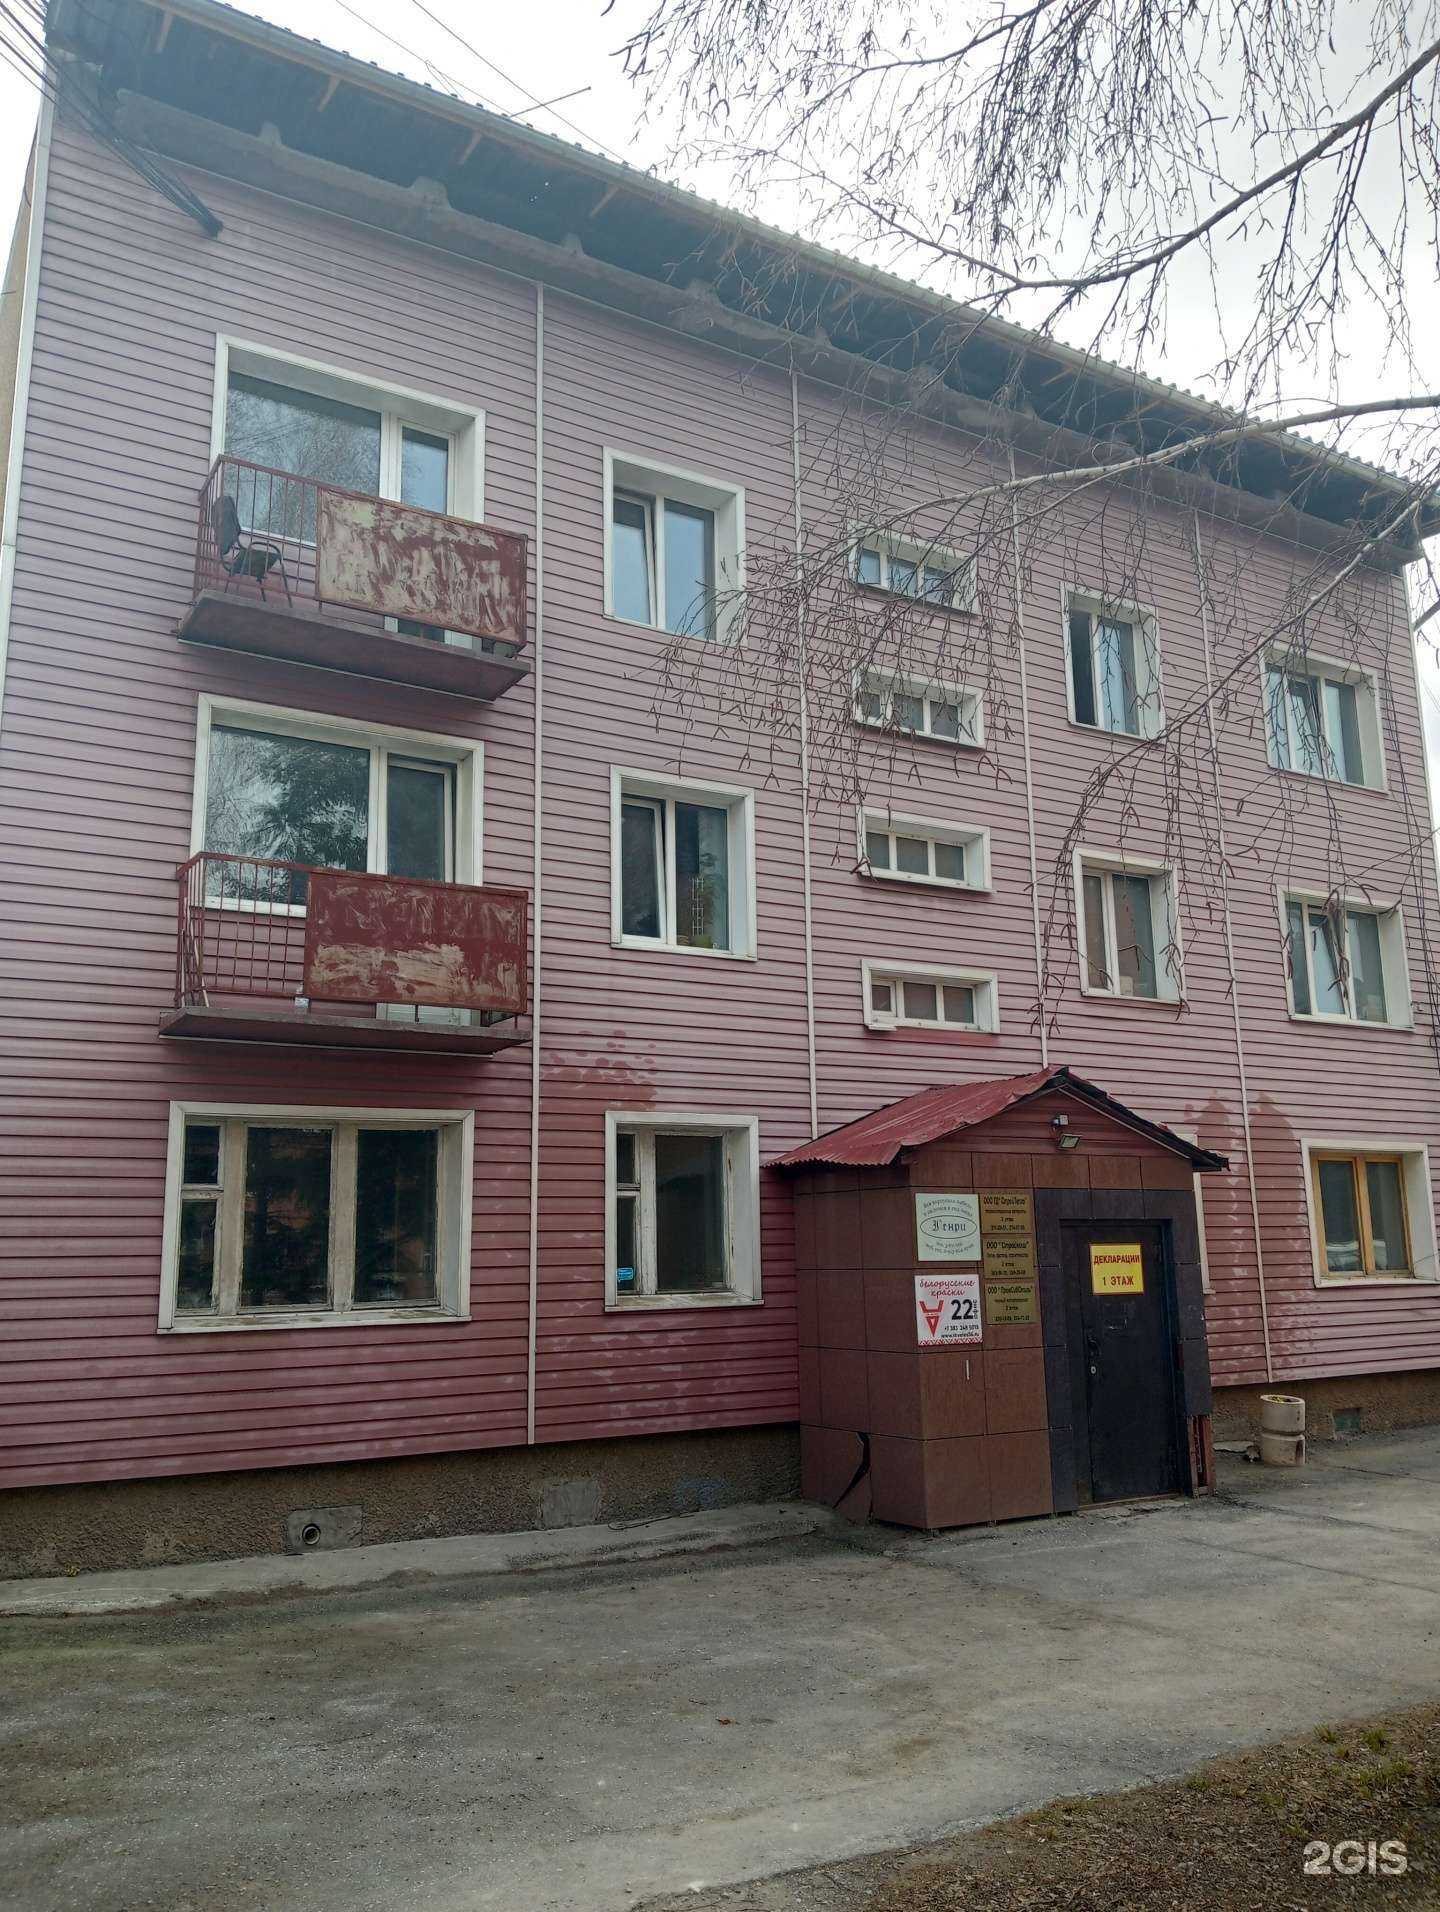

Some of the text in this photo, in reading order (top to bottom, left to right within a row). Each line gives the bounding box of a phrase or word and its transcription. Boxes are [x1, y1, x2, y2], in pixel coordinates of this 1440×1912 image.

[1094, 1254, 1140, 1266] ДЕКЛАРАЦИИ
[919, 1279, 977, 1290] белорусские
[1102, 1275, 1135, 1287] 1 ЭТАЖ
[929, 1289, 966, 1300] краски
[950, 1299, 974, 1320] 22
